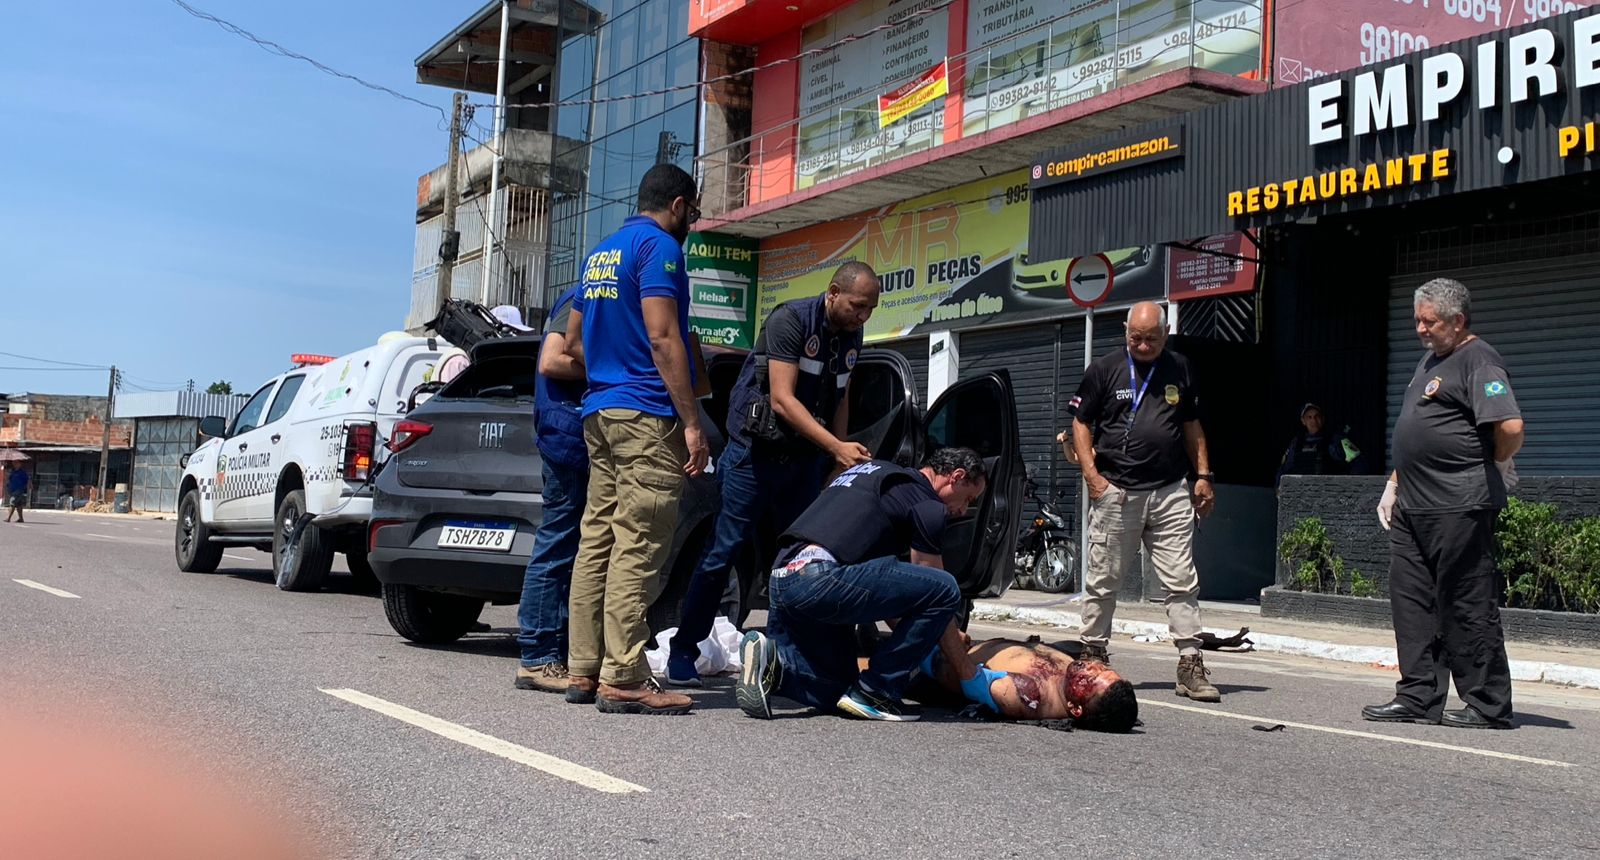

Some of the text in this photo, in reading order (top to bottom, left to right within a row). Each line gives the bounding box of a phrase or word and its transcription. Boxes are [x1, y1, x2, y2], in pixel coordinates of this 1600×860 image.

[982, 7, 1035, 34] TRIBUTÁRIA
[885, 29, 930, 55] FINANCEIRO
[811, 55, 841, 73] CRIMINAL
[885, 45, 928, 70] CONTRATOS
[1080, 46, 1143, 81] 992875115
[809, 81, 846, 101] AMBIENTAL
[999, 76, 1058, 107] 99382-8142
[1308, 16, 1600, 145] EMPIRE
[1046, 136, 1179, 177] @empireamazon_
[1228, 148, 1450, 217] RESTAURANTE
[689, 242, 720, 259] AQUI
[724, 247, 752, 262] TEM
[927, 255, 982, 285] PEÇAS
[699, 290, 729, 304] Heliar
[702, 335, 723, 345] mais
[1116, 393, 1133, 401] CIVI
[479, 422, 507, 448] FIAT
[248, 452, 271, 469] MILITAR
[446, 528, 505, 546] TSH7B78
